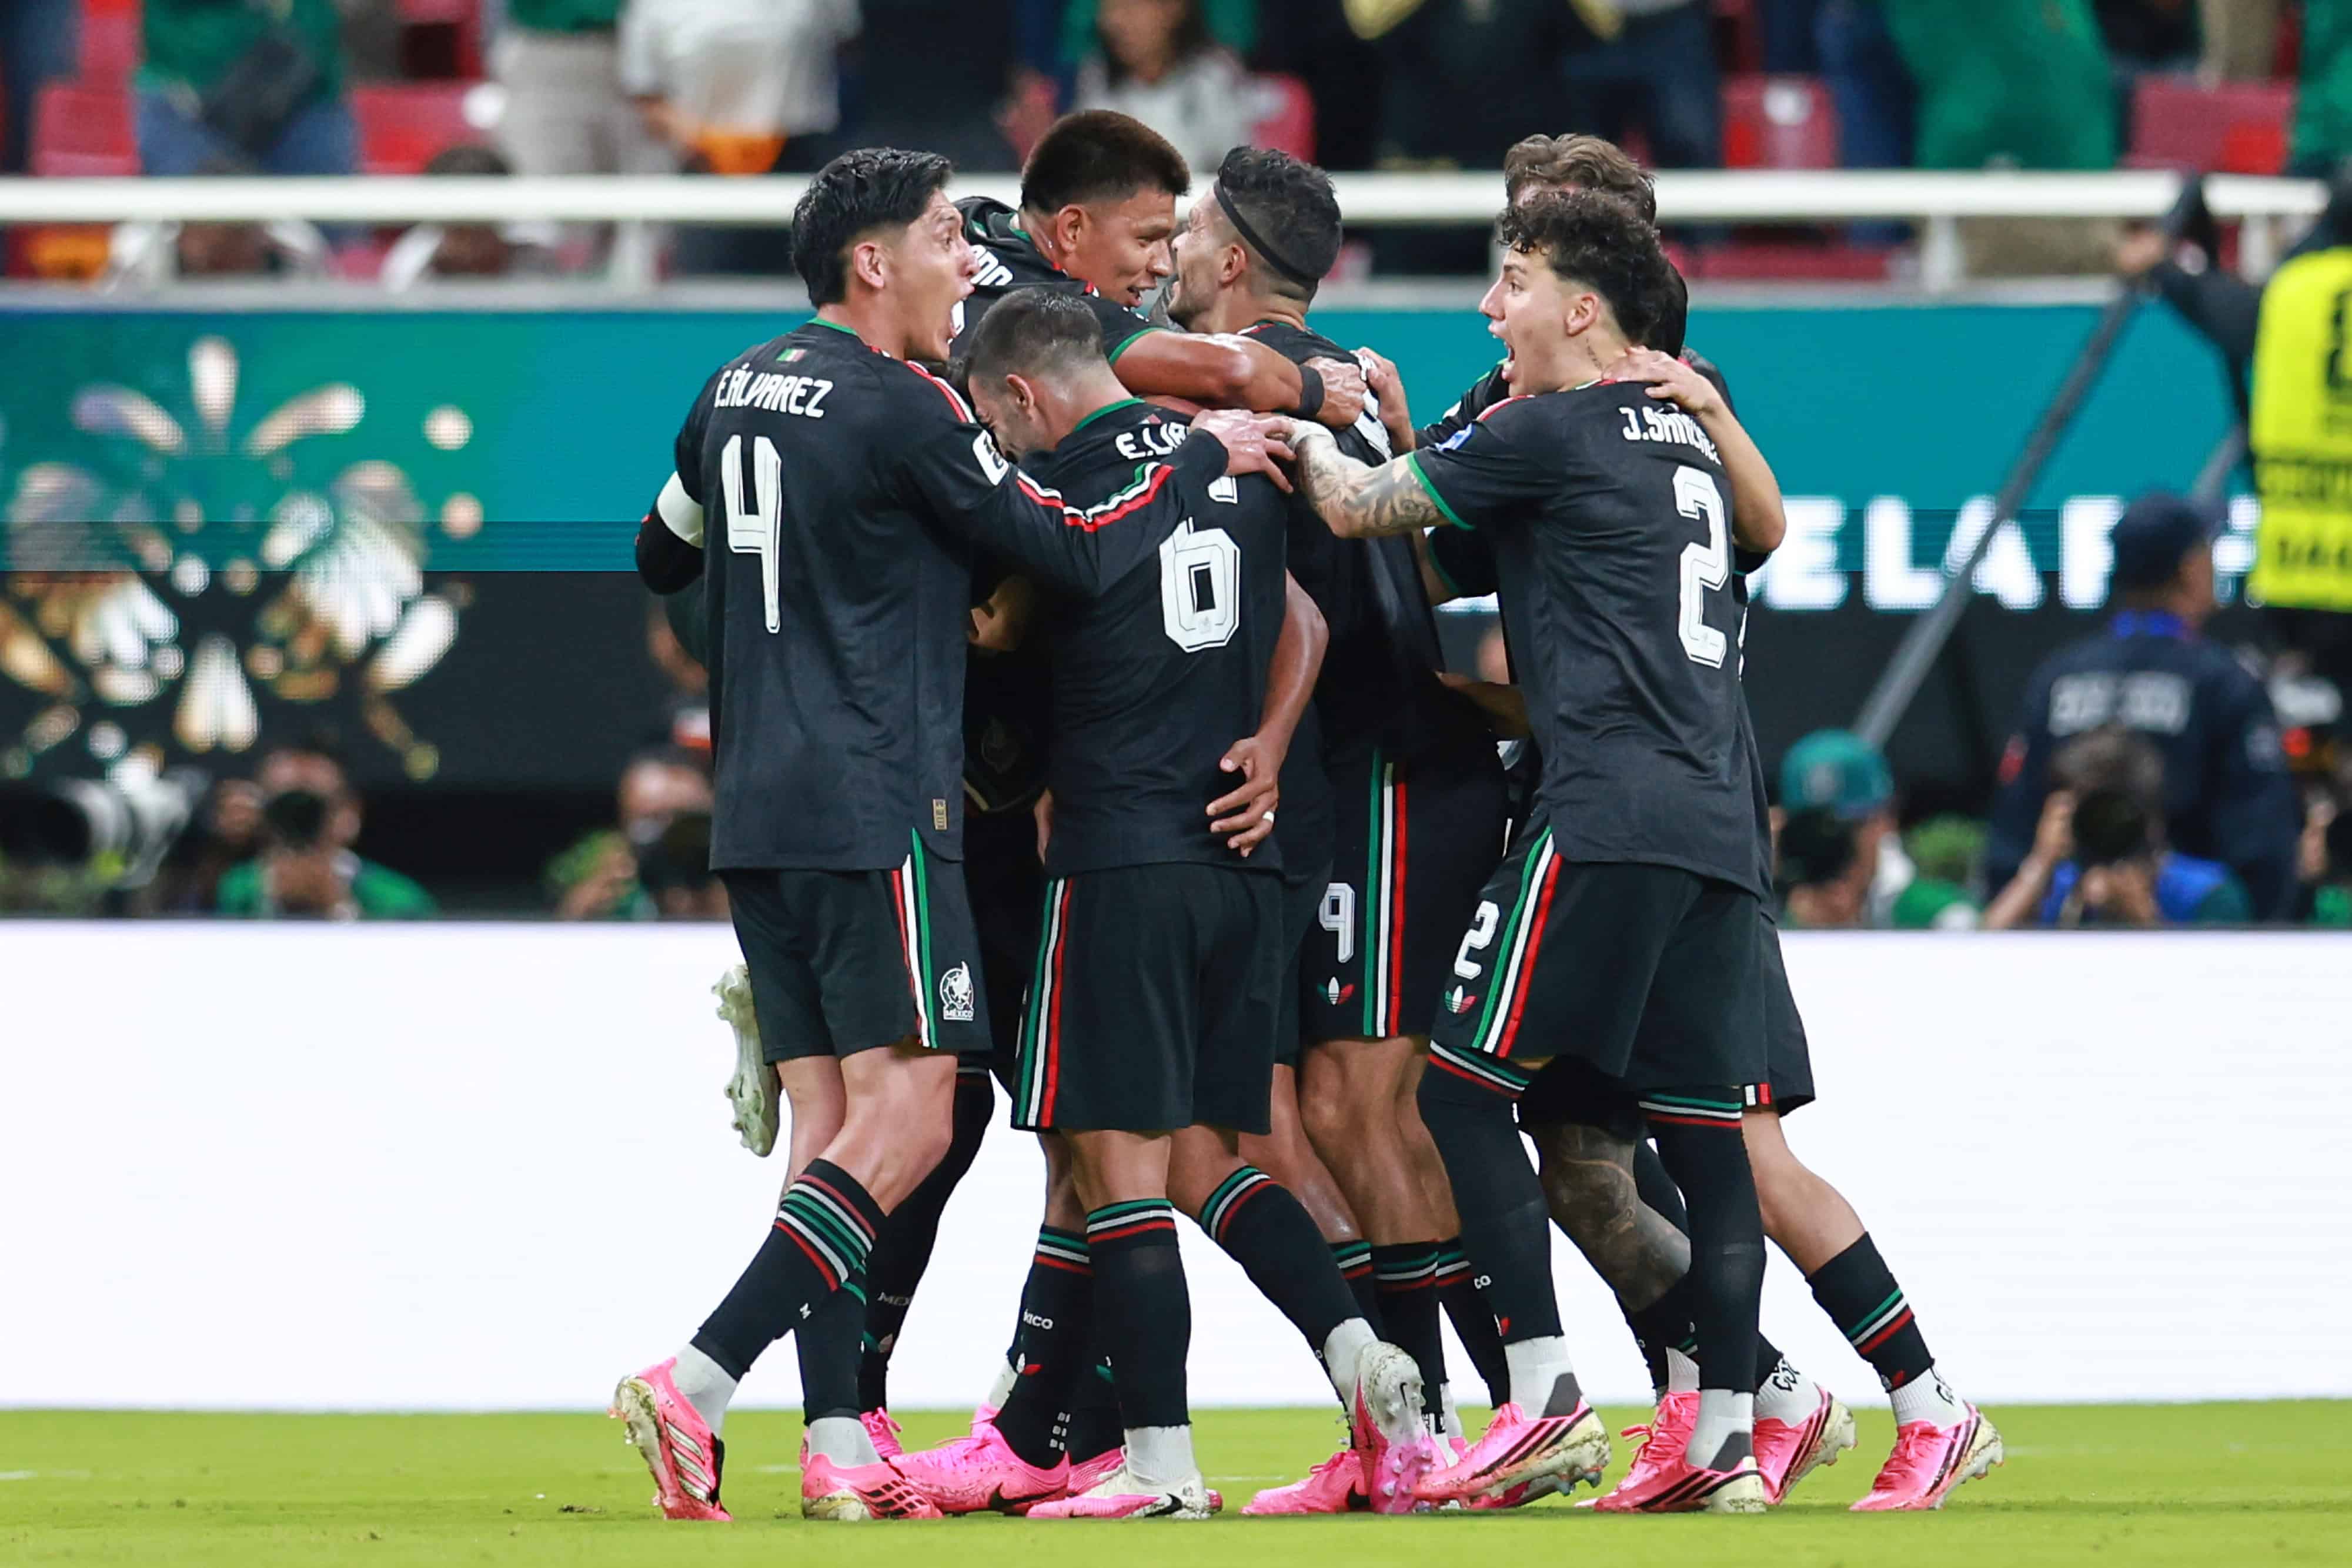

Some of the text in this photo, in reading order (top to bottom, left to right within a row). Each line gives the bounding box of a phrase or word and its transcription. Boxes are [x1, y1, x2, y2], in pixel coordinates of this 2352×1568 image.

[714, 363, 833, 418] E.ÁLVAREZ
[721, 434, 783, 634] 4
[1159, 476, 1241, 653] 6
[1672, 464, 1729, 670] 2
[1318, 882, 1355, 964] 9
[1454, 900, 1500, 980] 2
